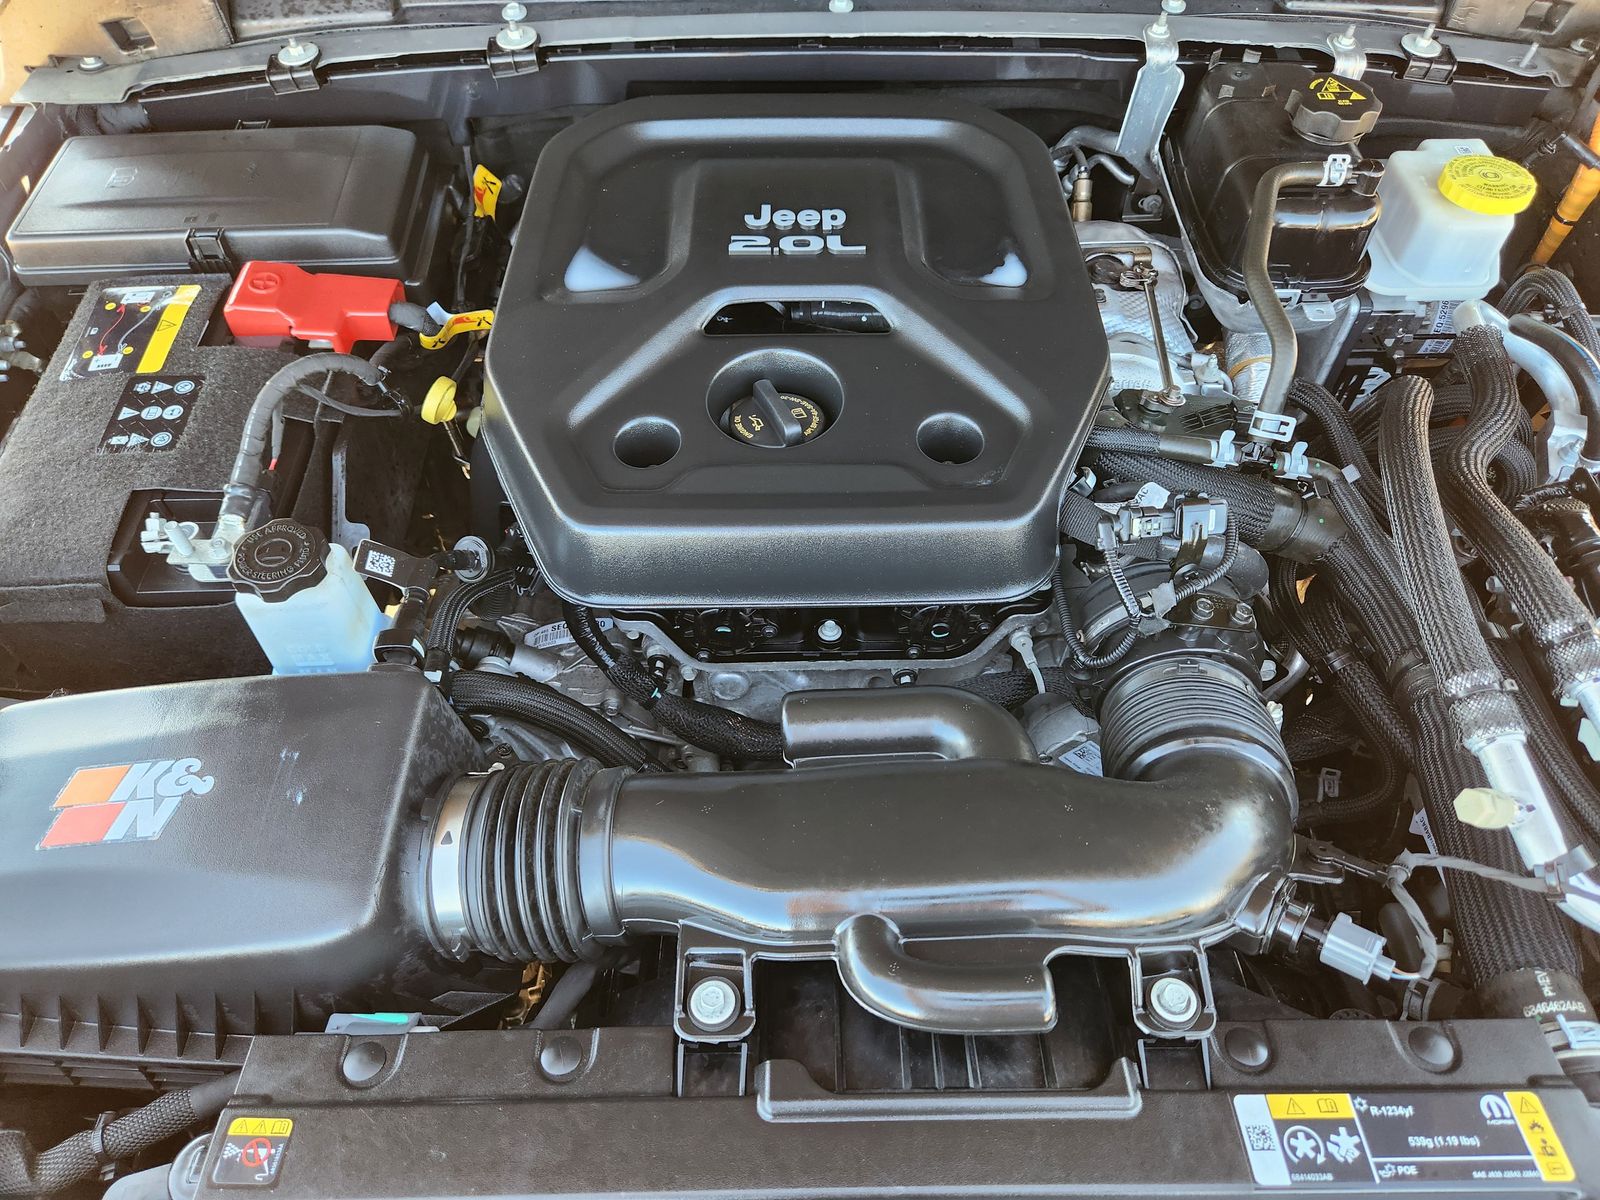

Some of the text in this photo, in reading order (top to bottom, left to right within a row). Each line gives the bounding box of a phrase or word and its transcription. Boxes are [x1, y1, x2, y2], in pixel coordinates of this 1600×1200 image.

[744, 203, 847, 234] Jeep
[728, 235, 867, 256] 2.0L
[734, 423, 754, 439] ENGINE
[246, 524, 307, 544] USE APPROVED
[237, 553, 253, 577] POWER
[251, 565, 295, 580] STEERING
[1534, 970, 1556, 997] PHEV
[1370, 1104, 1415, 1119] R-1234yf
[1408, 1134, 1481, 1149] 539g (1.19 lbs)
[1397, 1165, 1418, 1176] POE
